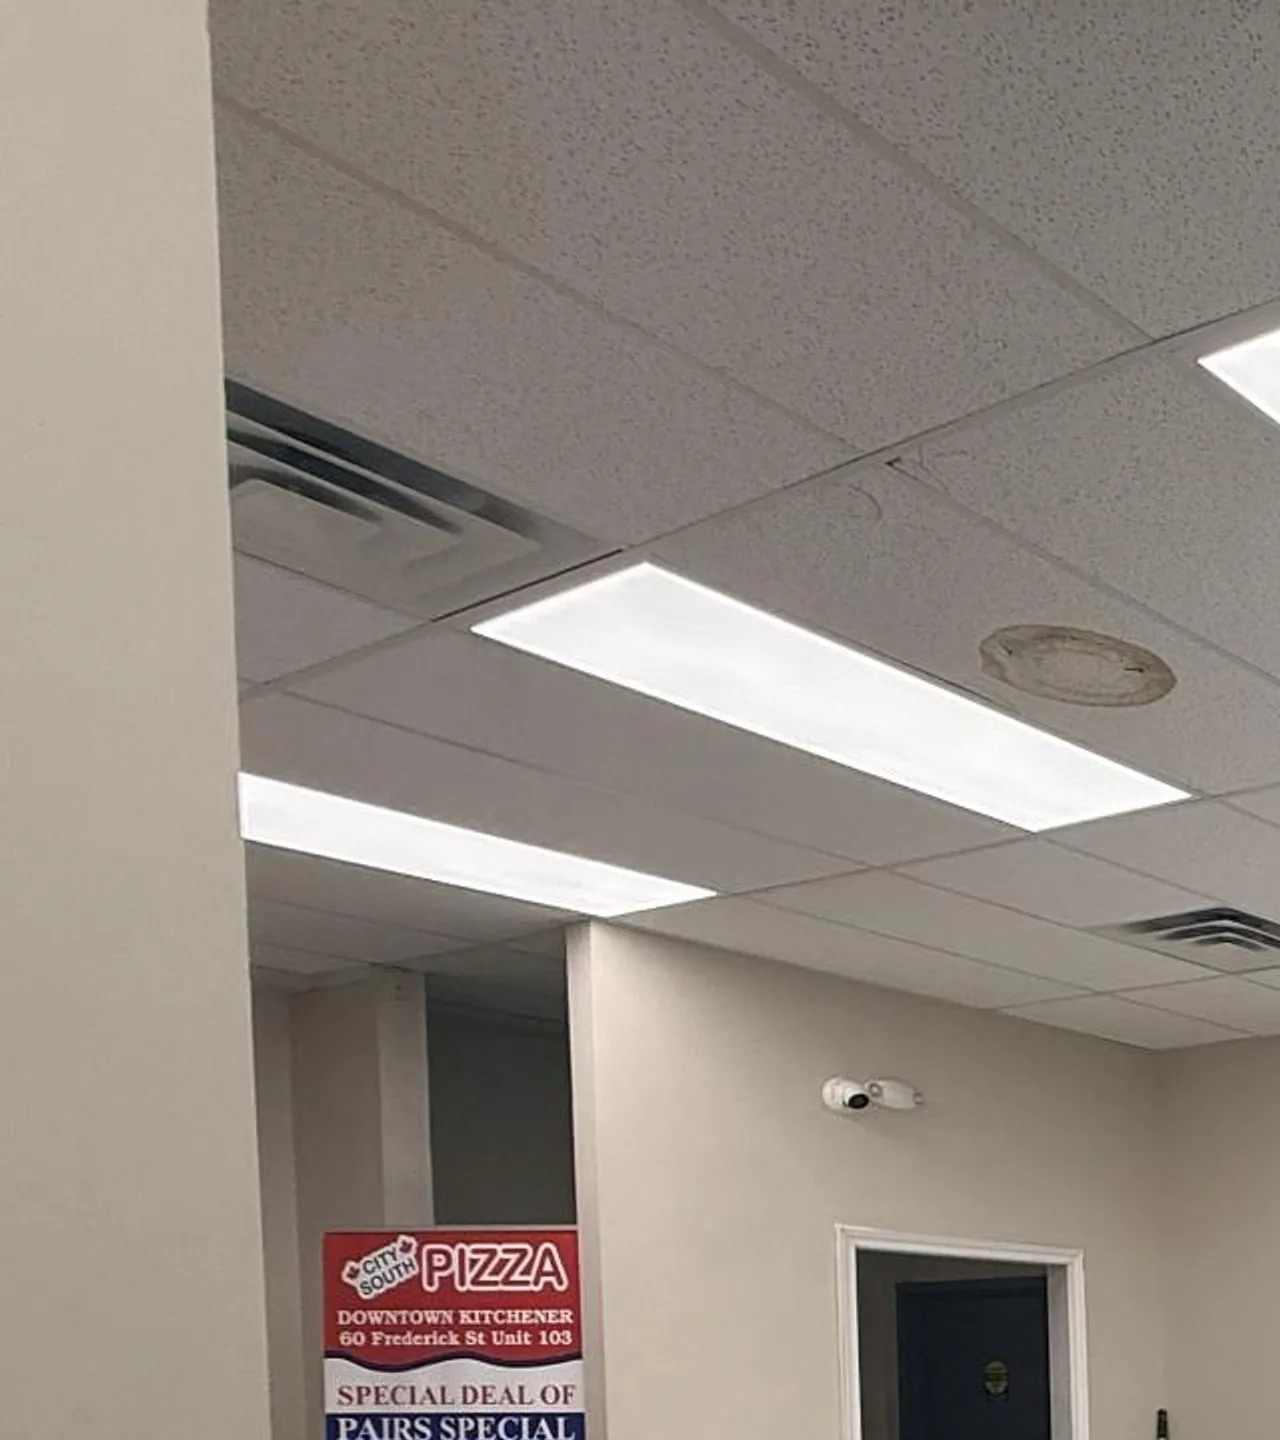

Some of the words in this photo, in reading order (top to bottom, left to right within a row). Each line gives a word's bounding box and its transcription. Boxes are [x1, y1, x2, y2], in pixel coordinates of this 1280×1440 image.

[362, 1245, 400, 1275] CITY
[421, 1242, 569, 1292] PIZZA
[359, 1259, 416, 1296] SOUTH
[337, 1310, 453, 1325] DOWNTOWN
[459, 1310, 574, 1325] KITCHENER
[339, 1332, 365, 1346] 60
[371, 1330, 459, 1346] Frederick
[465, 1331, 485, 1345] St
[492, 1330, 532, 1345] Unit
[539, 1330, 573, 1346] 103
[337, 1385, 455, 1406] SPECIAL
[461, 1385, 532, 1406] DEAL
[540, 1384, 577, 1405] OF
